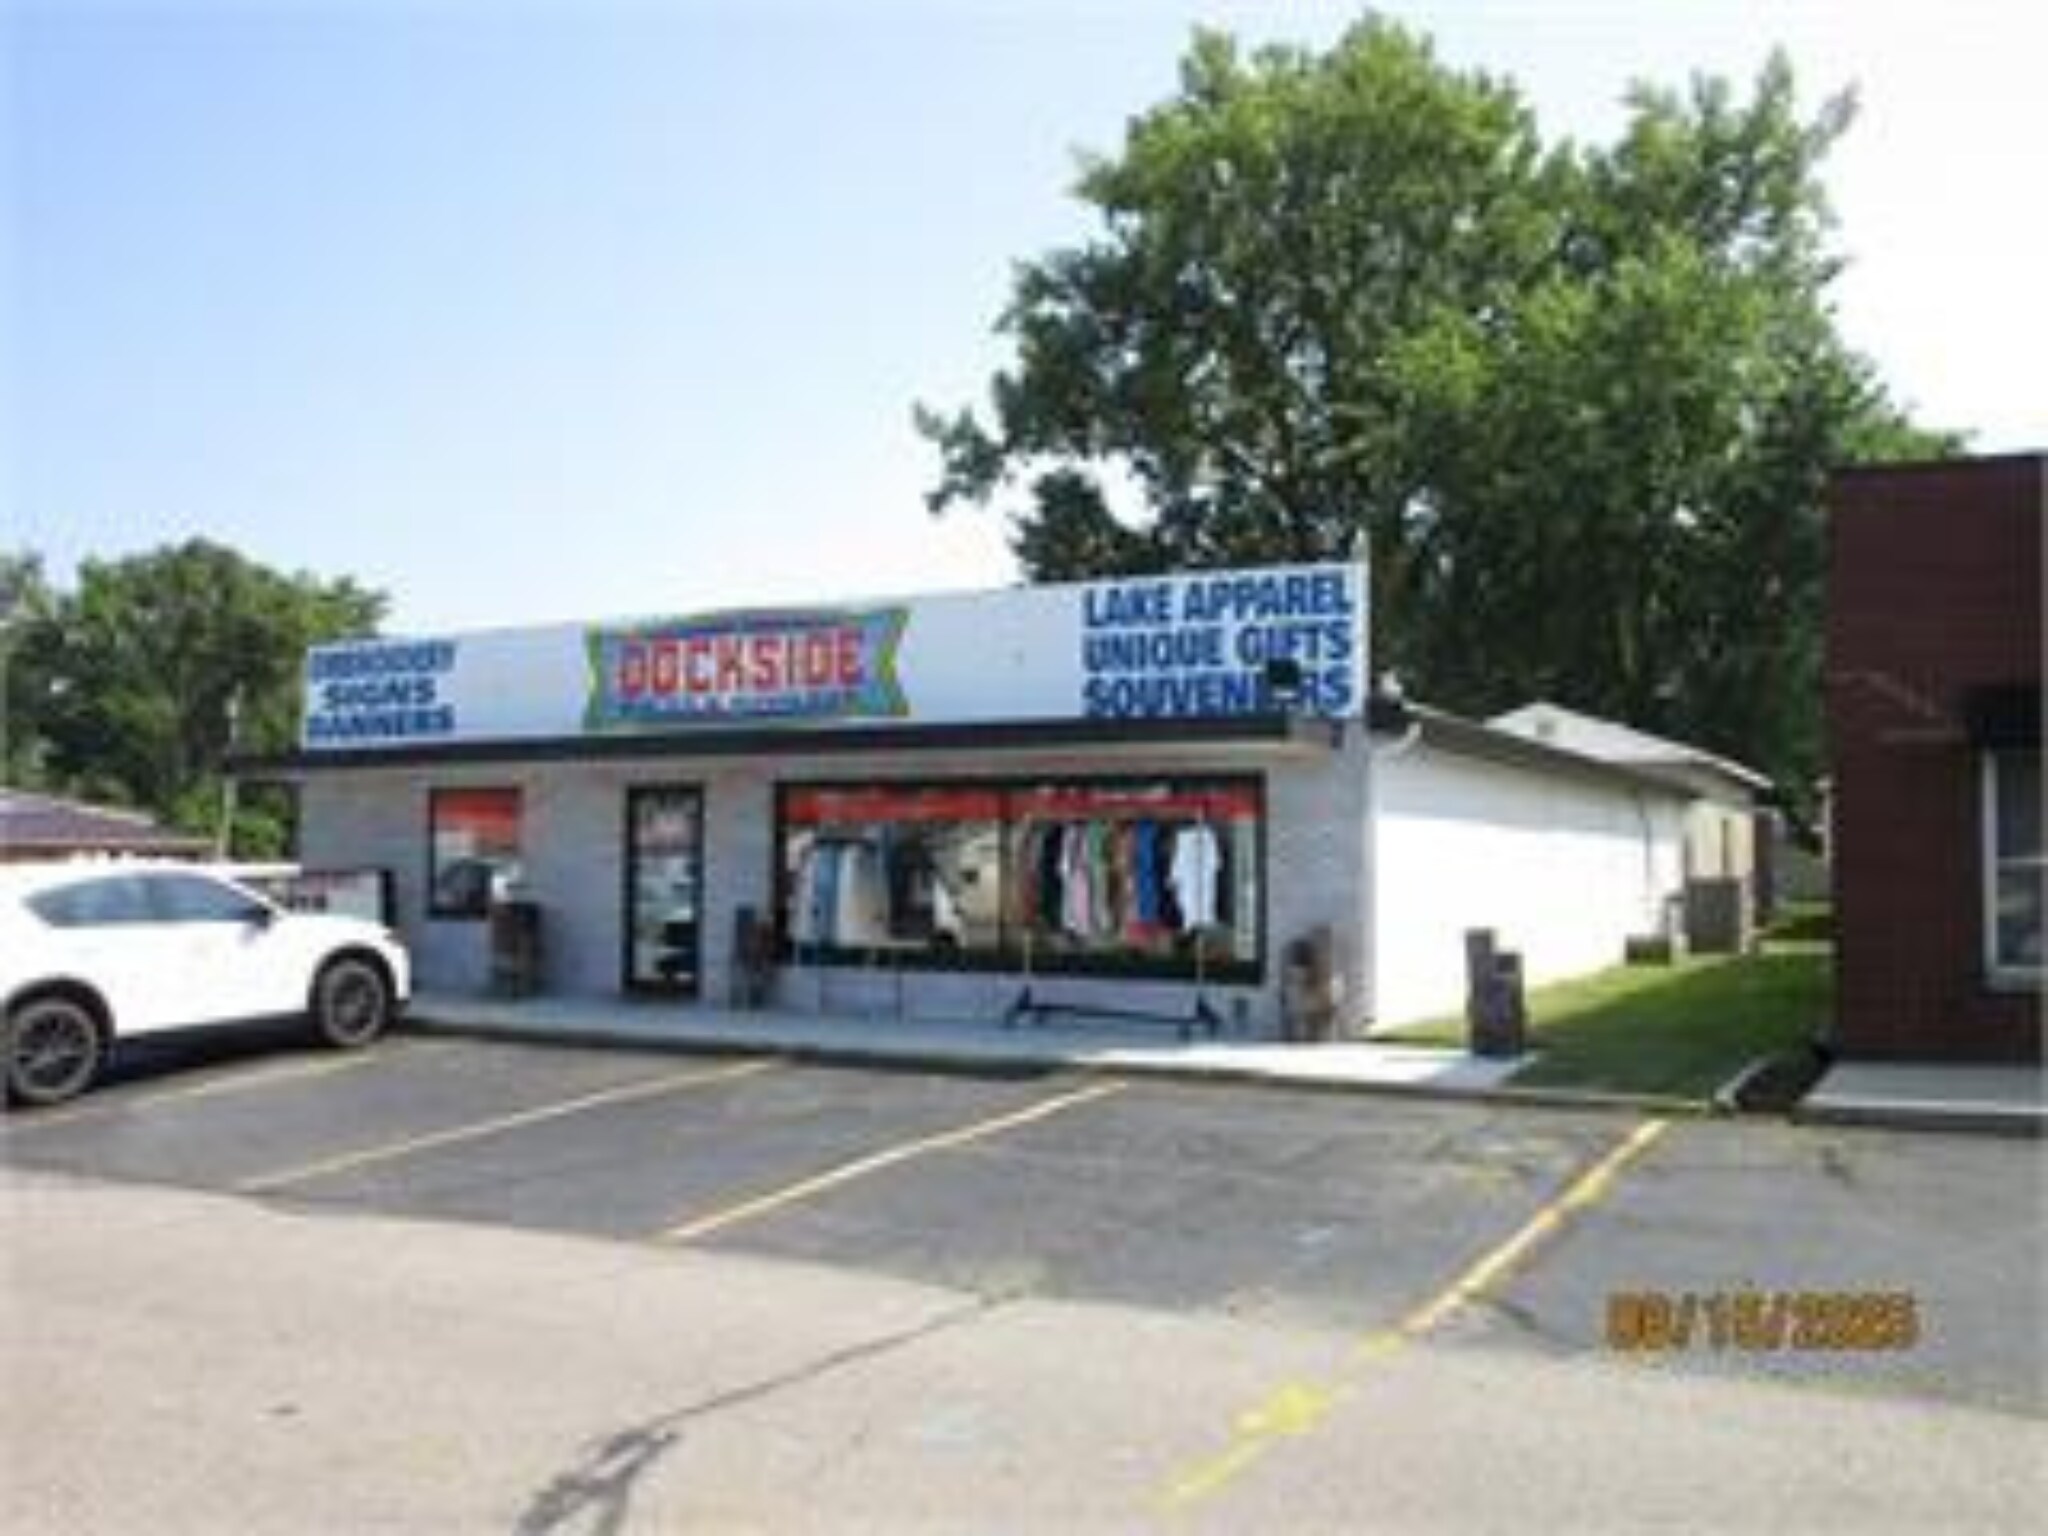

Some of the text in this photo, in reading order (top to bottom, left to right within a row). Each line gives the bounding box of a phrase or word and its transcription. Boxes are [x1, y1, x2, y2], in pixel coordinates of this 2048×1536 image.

[1086, 571, 1352, 627] LAKE APPAREL
[617, 626, 864, 698] DOCKSIDE
[1083, 617, 1351, 673] UNIQUE GIFTS
[323, 676, 436, 708] SIGNS
[308, 704, 455, 738] BANNERS
